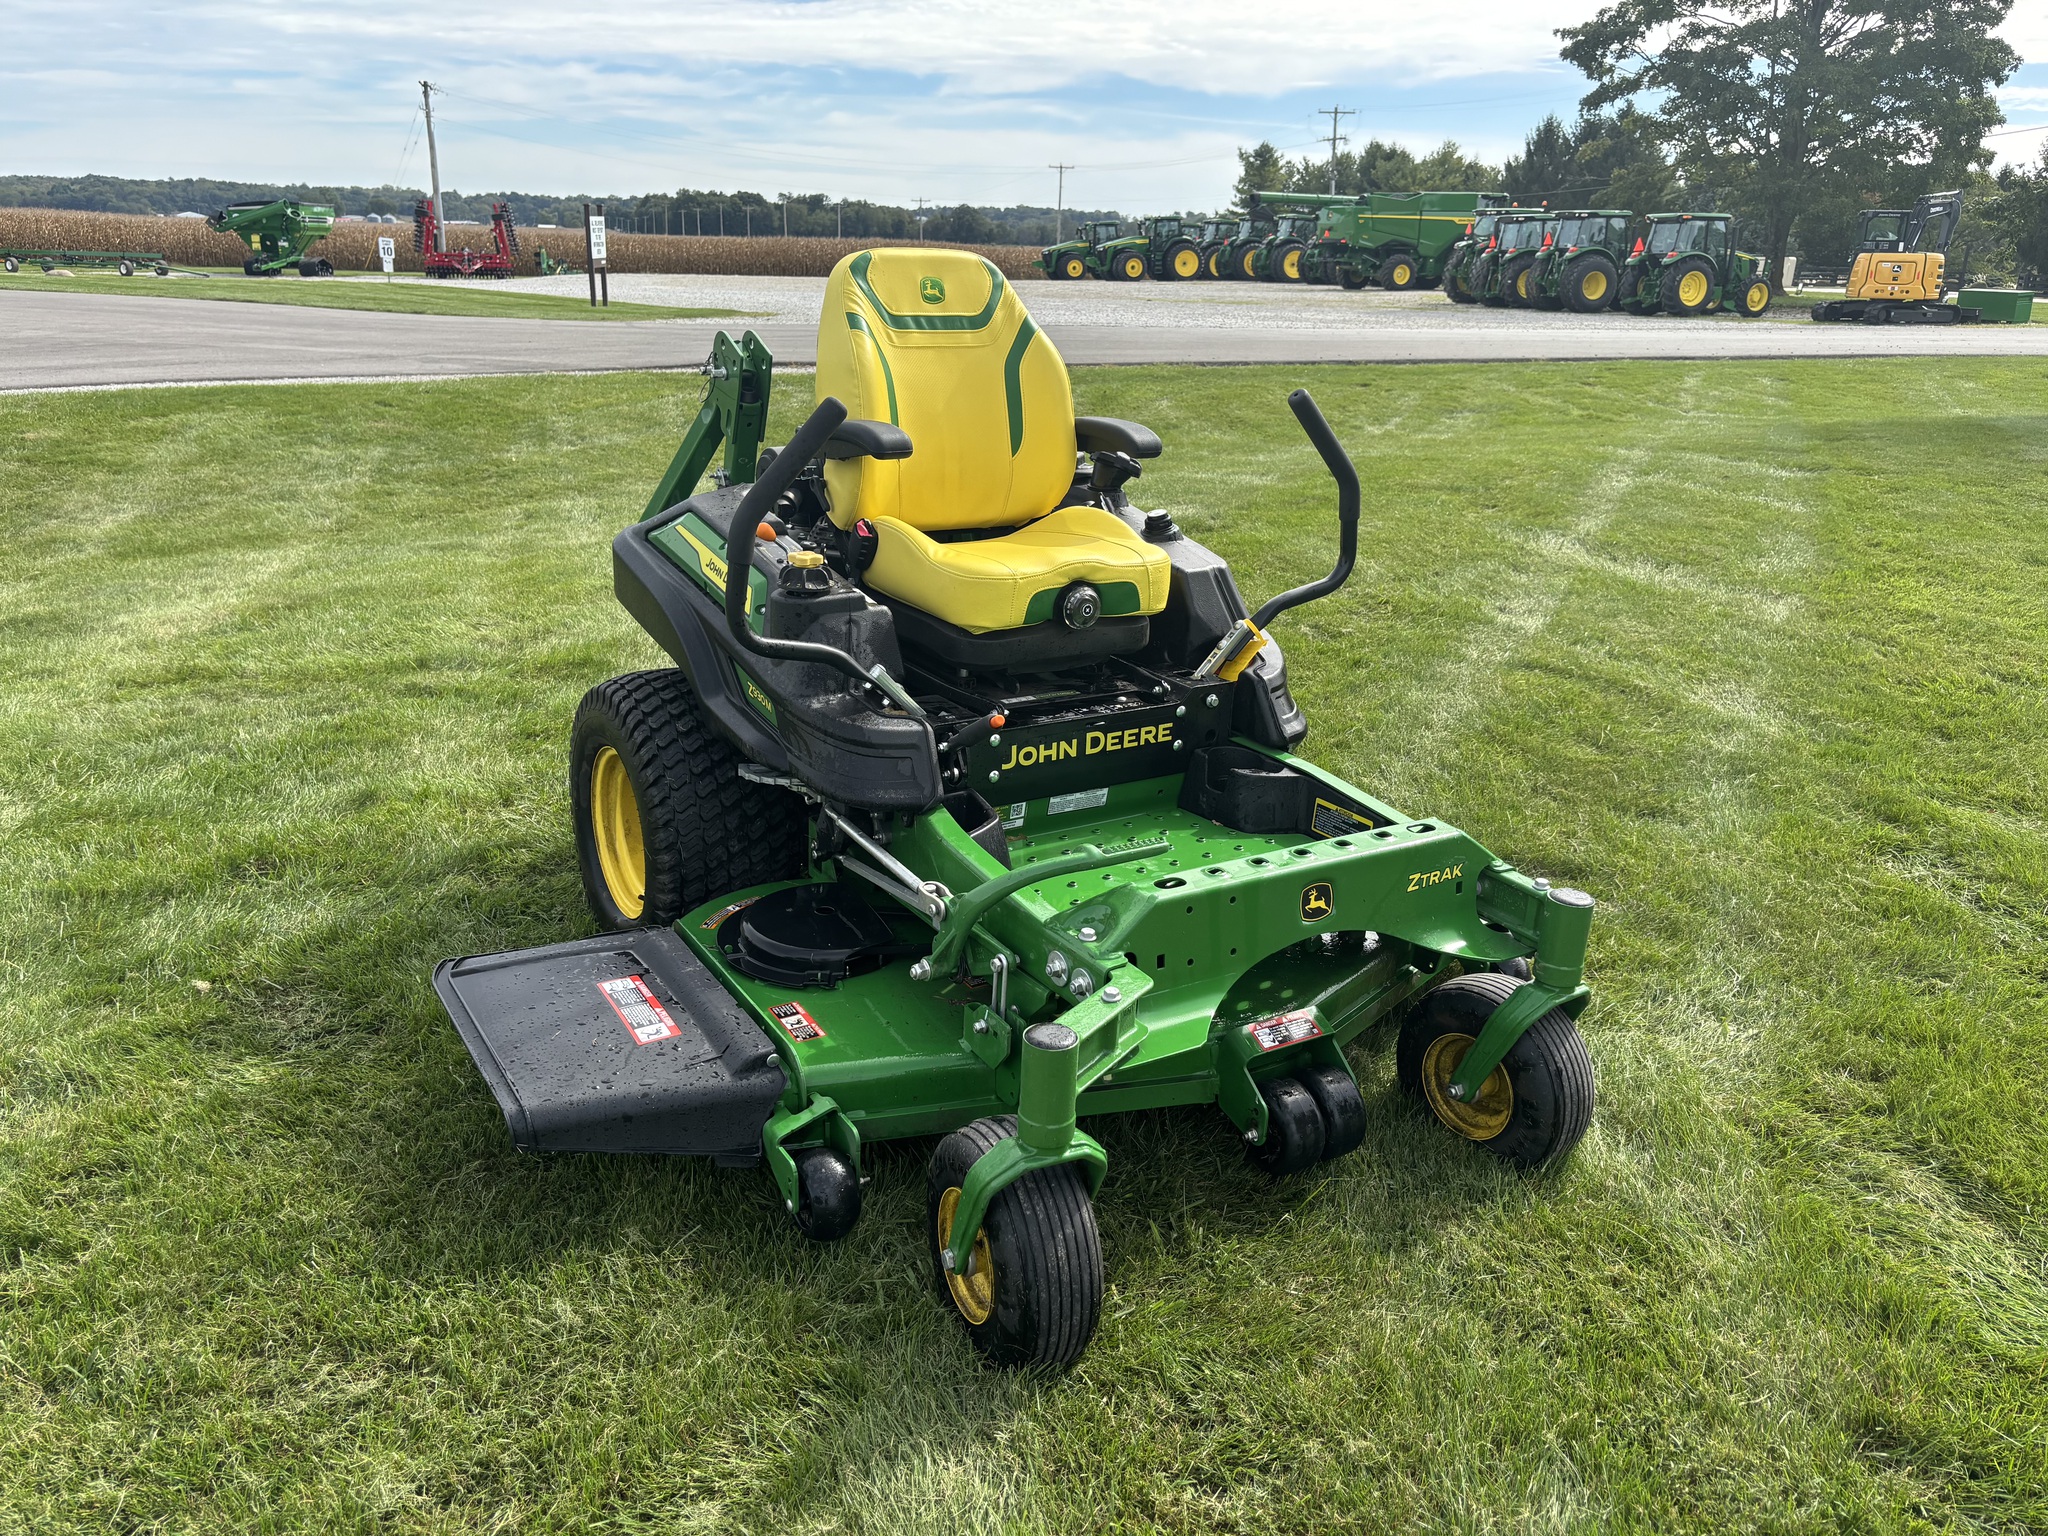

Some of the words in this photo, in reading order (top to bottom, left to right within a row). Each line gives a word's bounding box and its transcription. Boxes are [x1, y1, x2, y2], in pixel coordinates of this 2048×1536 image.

[382, 246, 392, 256] 10
[705, 558, 724, 580] JOHN
[1001, 738, 1078, 770] JOHN
[1085, 722, 1173, 755] DEERE
[1407, 863, 1464, 892] ZTRAK
